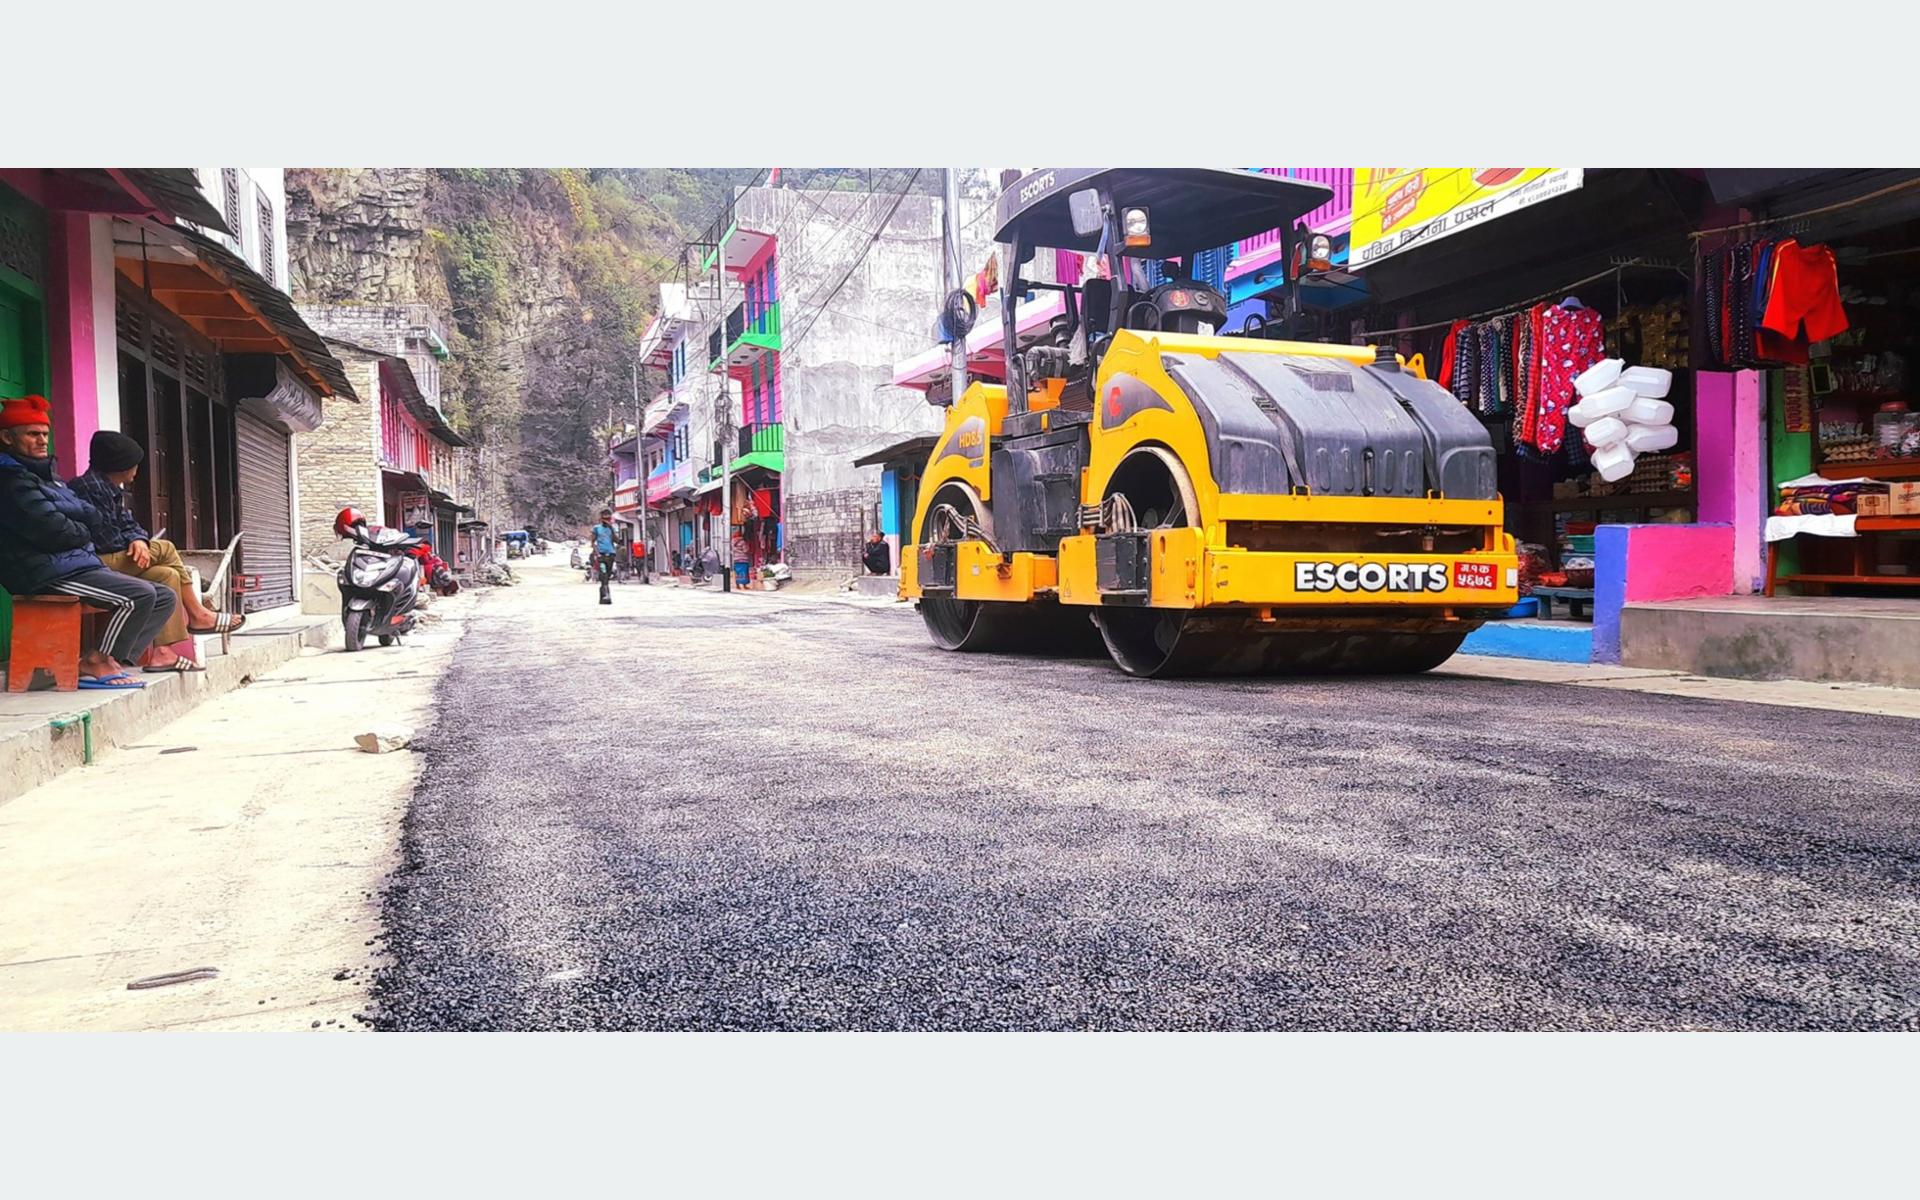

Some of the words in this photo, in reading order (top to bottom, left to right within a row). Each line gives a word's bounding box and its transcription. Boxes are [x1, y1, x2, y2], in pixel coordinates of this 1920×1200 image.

[1020, 171, 1056, 203] ESCORTS
[1454, 199, 1496, 225] पसल
[1295, 562, 1448, 592] ESCORTS
